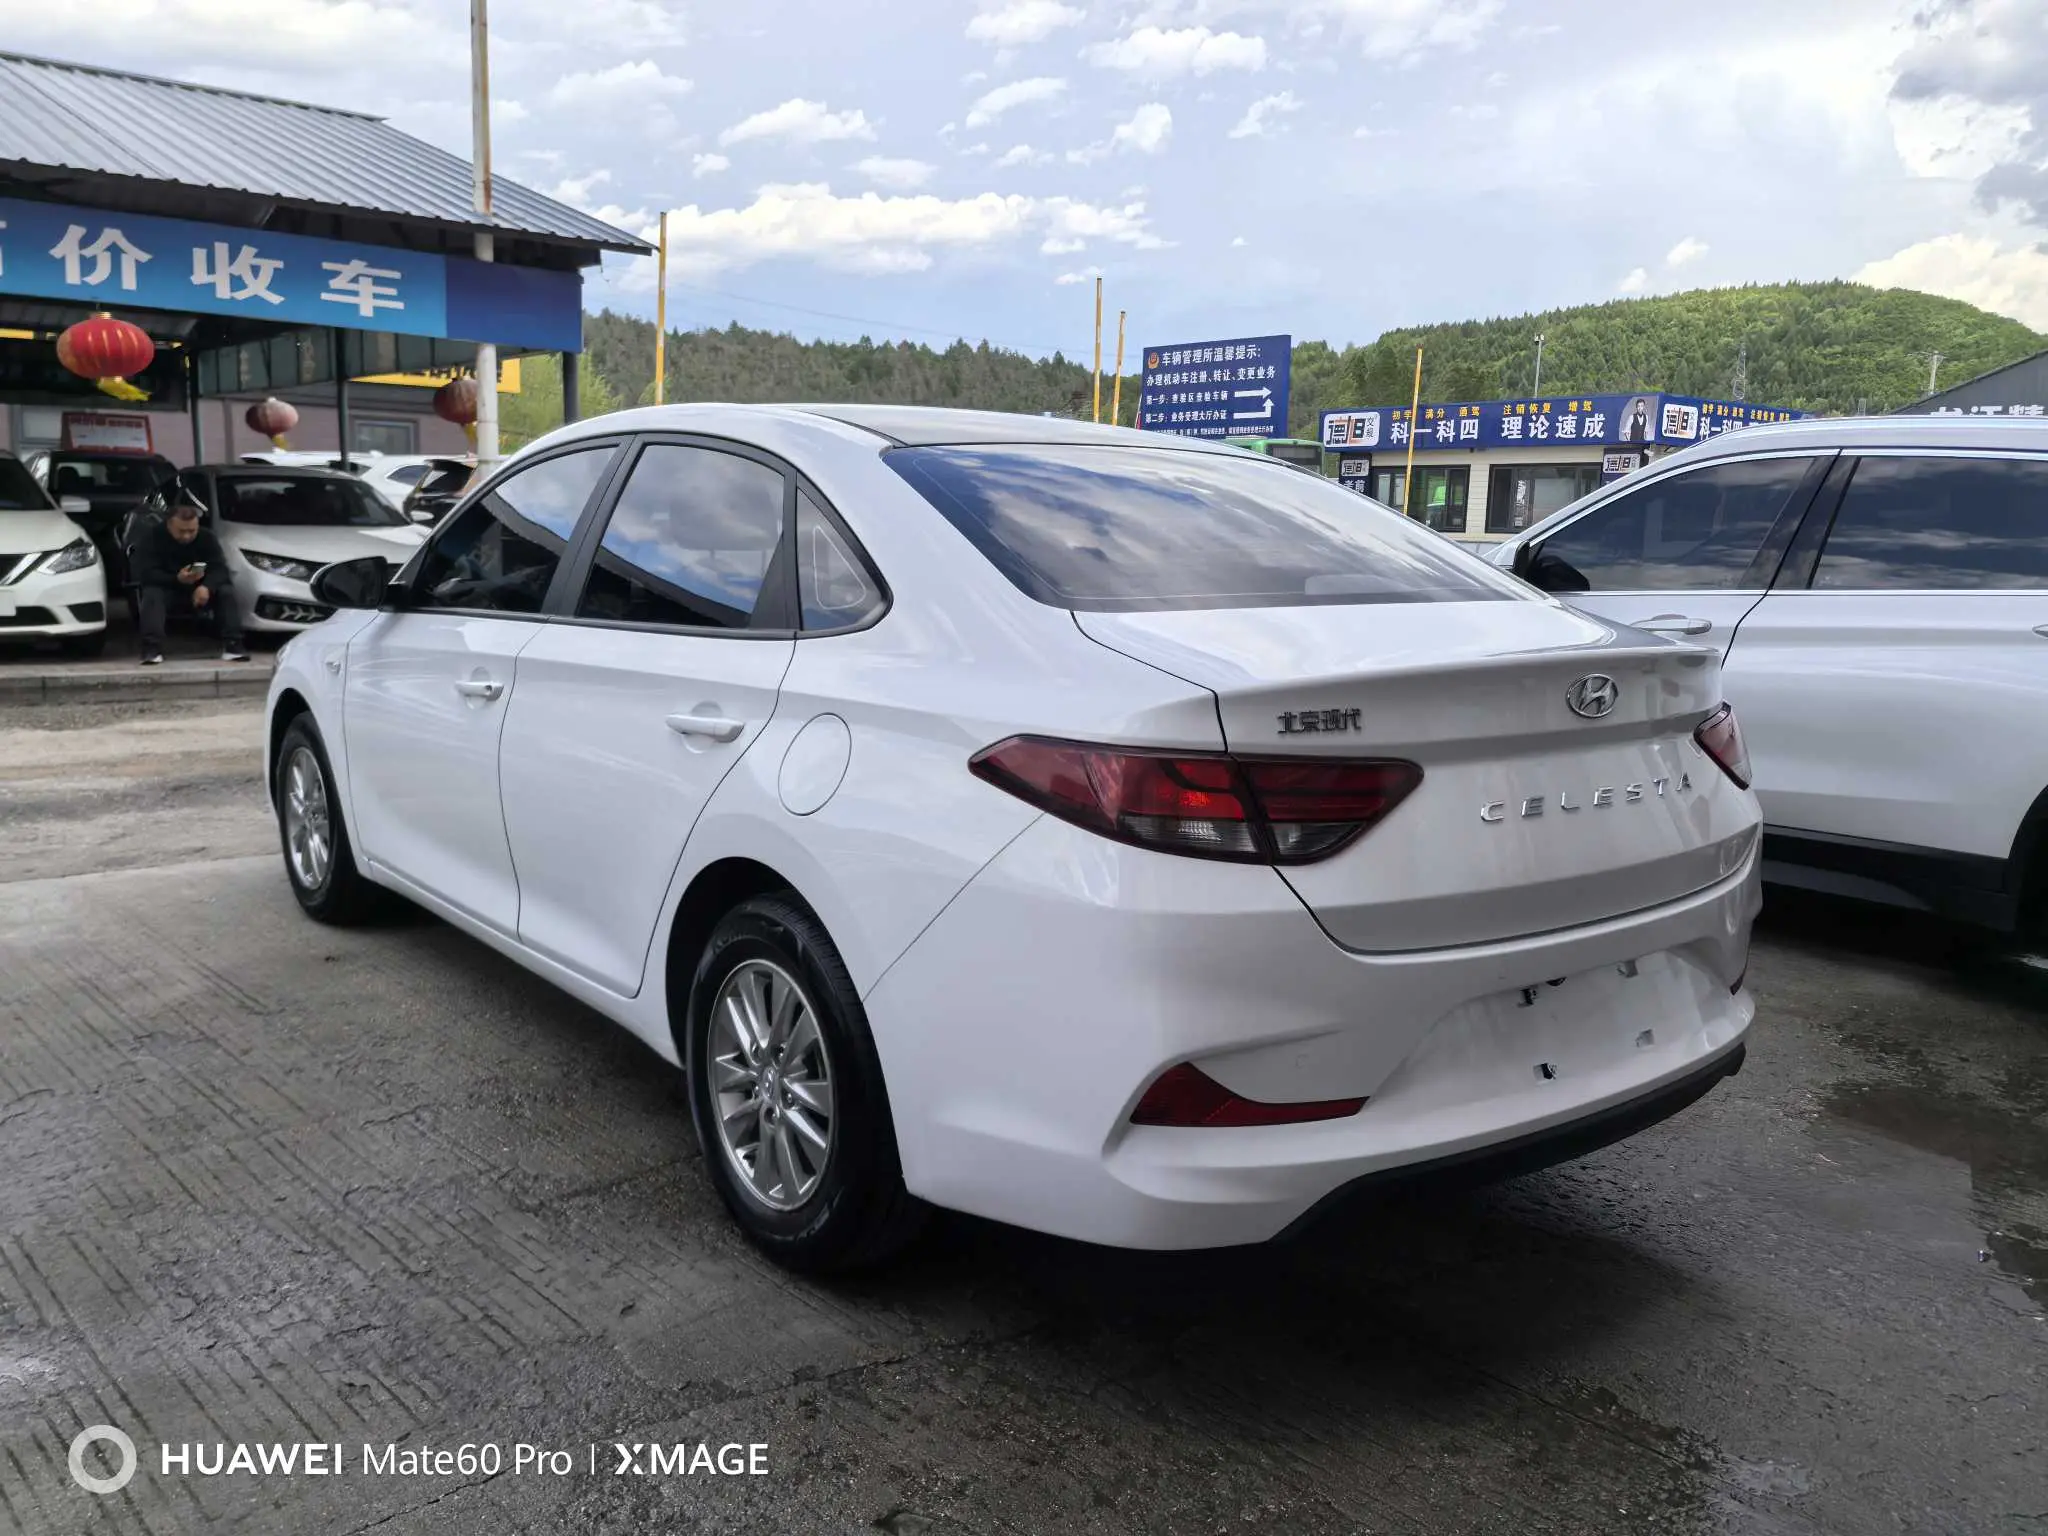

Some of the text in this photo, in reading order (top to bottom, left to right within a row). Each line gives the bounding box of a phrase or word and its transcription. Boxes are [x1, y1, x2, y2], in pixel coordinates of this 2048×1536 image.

[0, 221, 405, 318] 价收车
[1501, 413, 1606, 439] 理论速成
[1276, 707, 1363, 735] 北京现代
[1480, 771, 1693, 823] CELESTA
